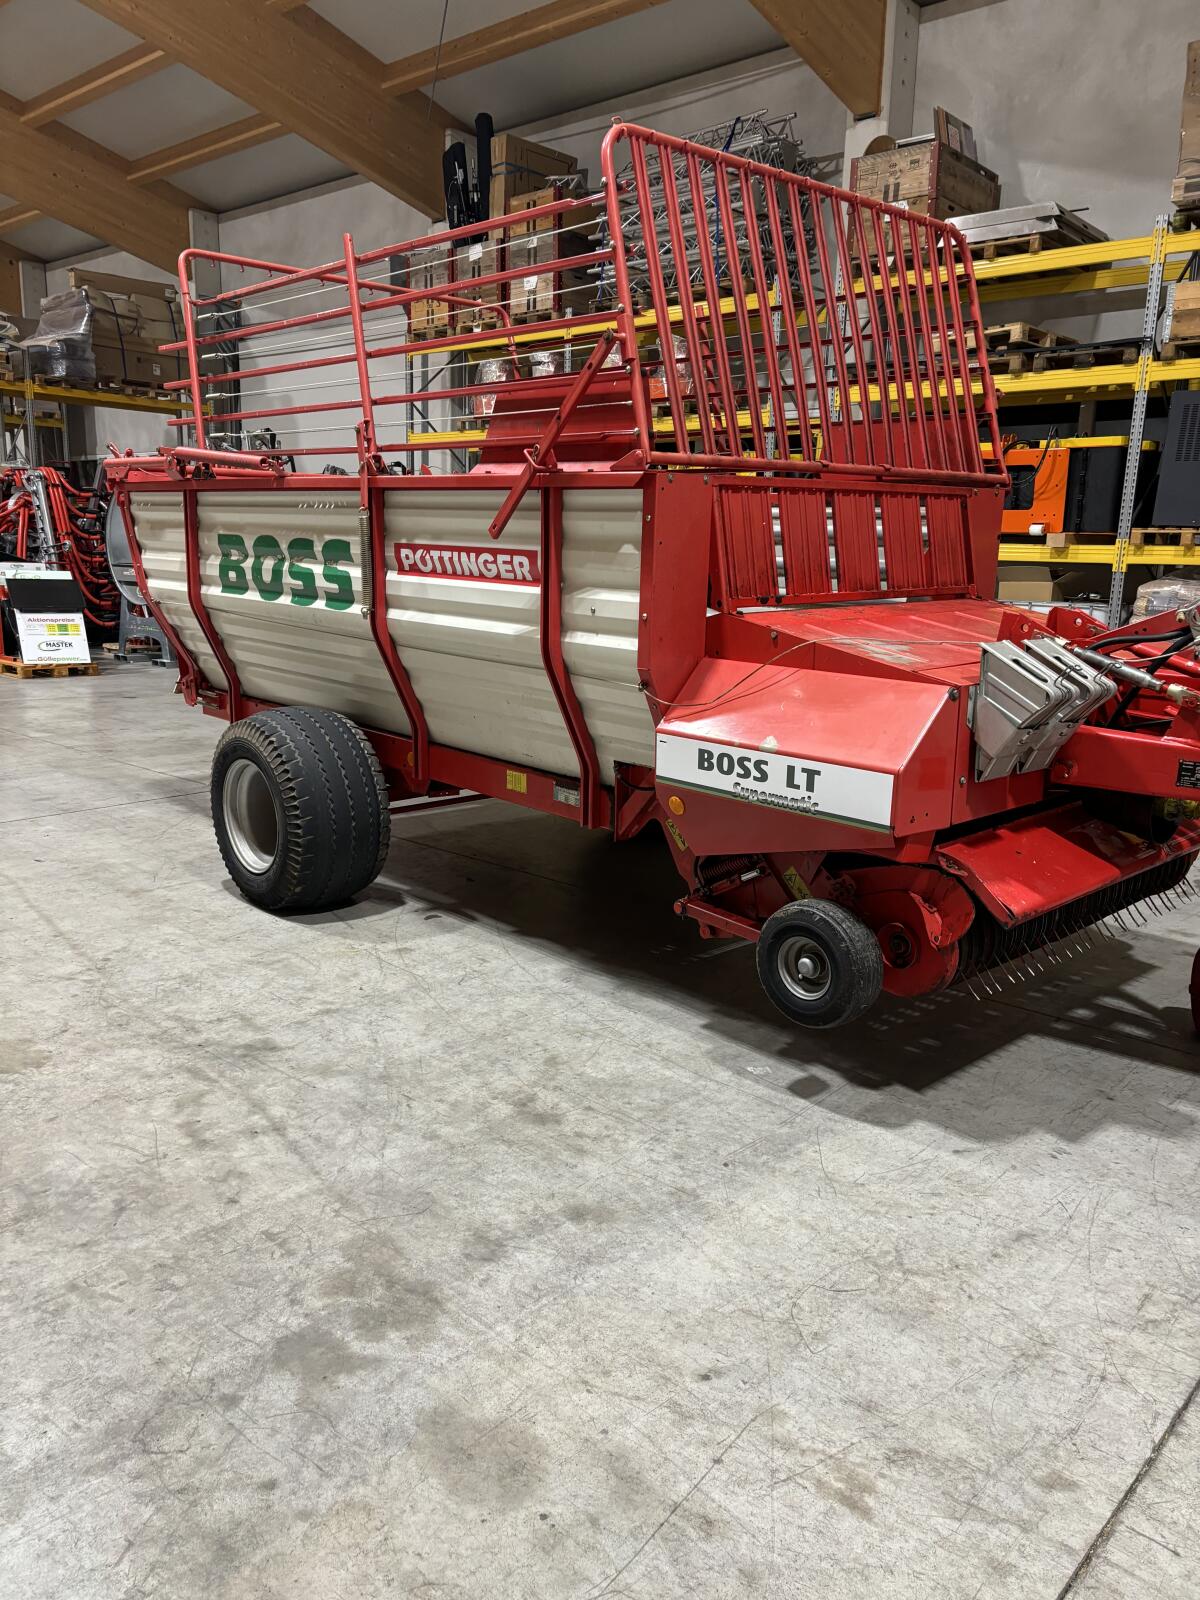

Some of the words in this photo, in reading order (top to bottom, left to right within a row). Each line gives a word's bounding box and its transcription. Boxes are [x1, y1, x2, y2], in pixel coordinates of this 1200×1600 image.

[217, 533, 356, 611] BOSS
[697, 748, 769, 783] BOSS
[785, 764, 822, 793] LT
[732, 782, 819, 815] Supermatic
